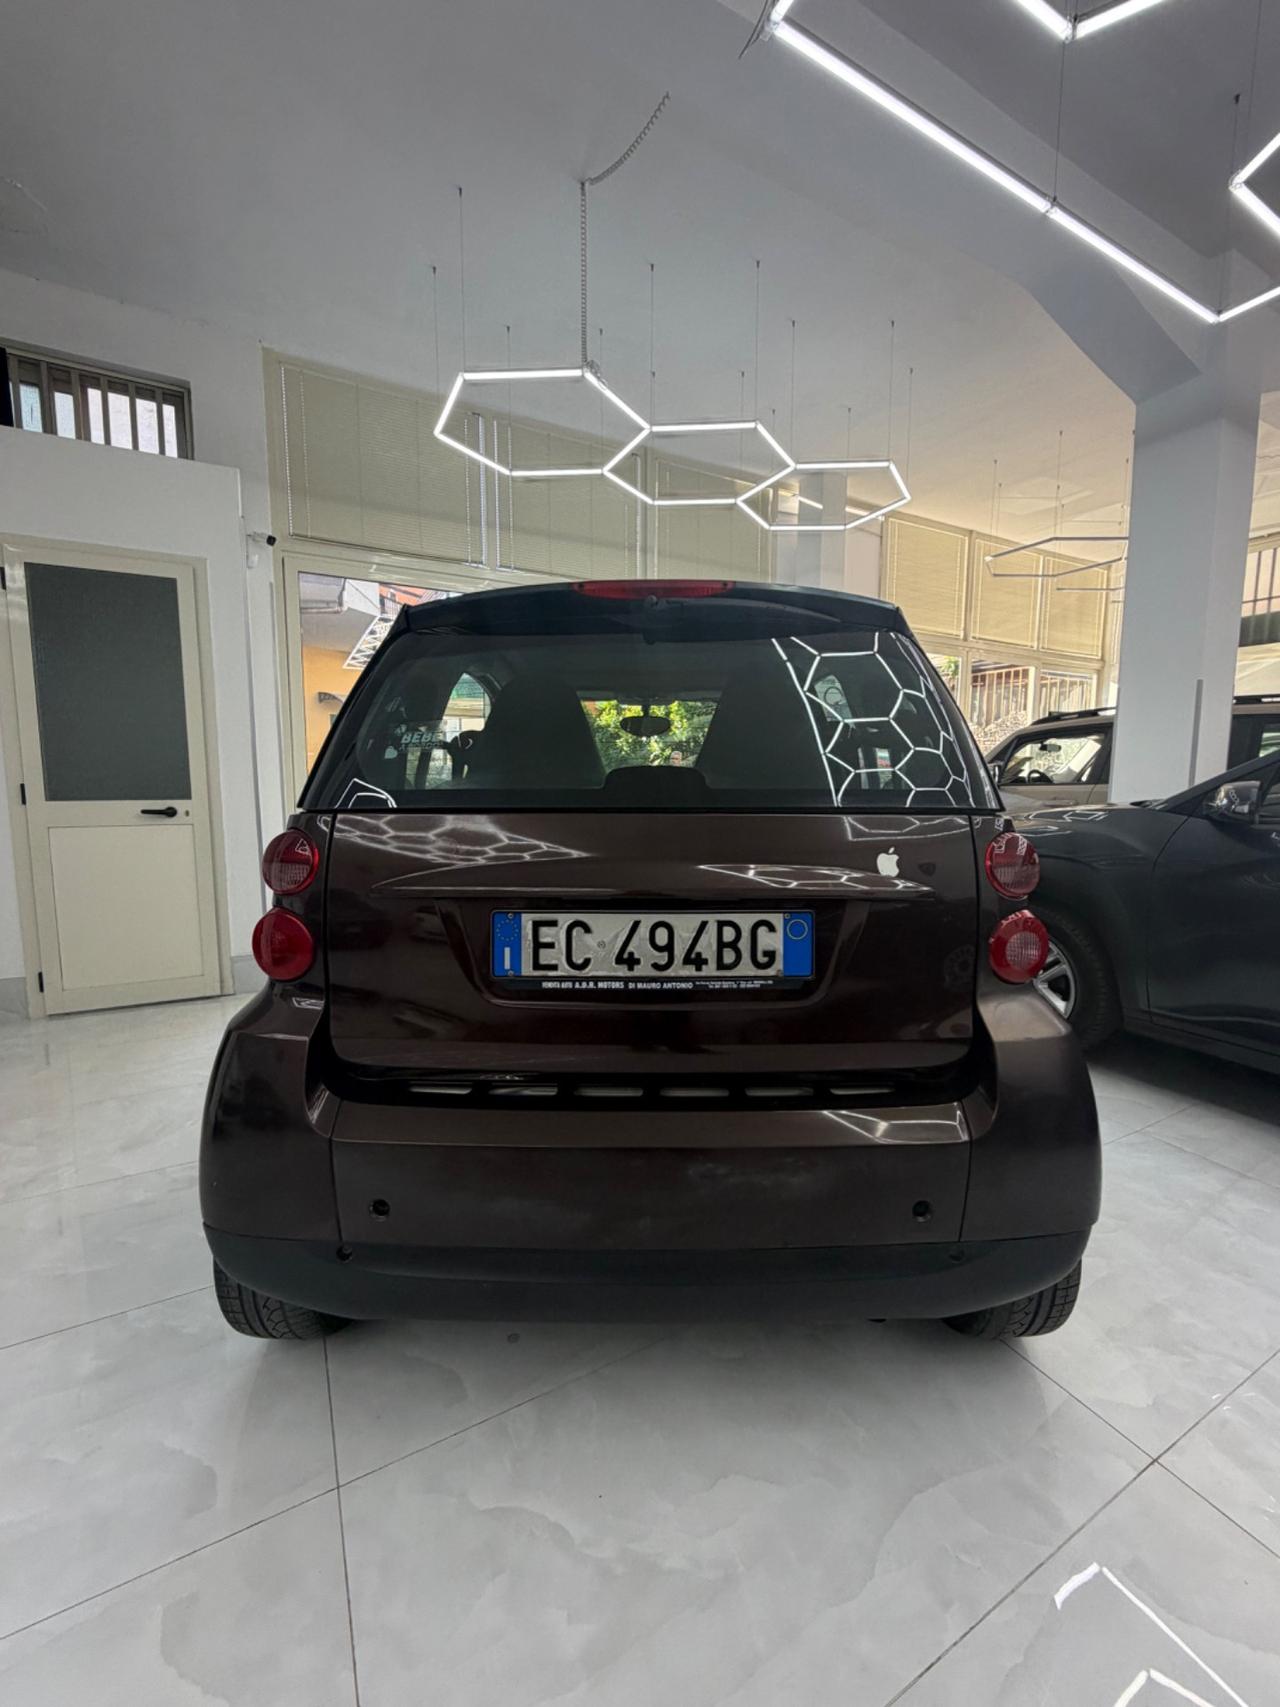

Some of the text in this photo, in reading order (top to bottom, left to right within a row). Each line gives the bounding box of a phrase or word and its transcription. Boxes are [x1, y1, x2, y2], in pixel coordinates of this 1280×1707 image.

[531, 919, 777, 972] EC 494BG
[597, 981, 625, 989] MOTORS
